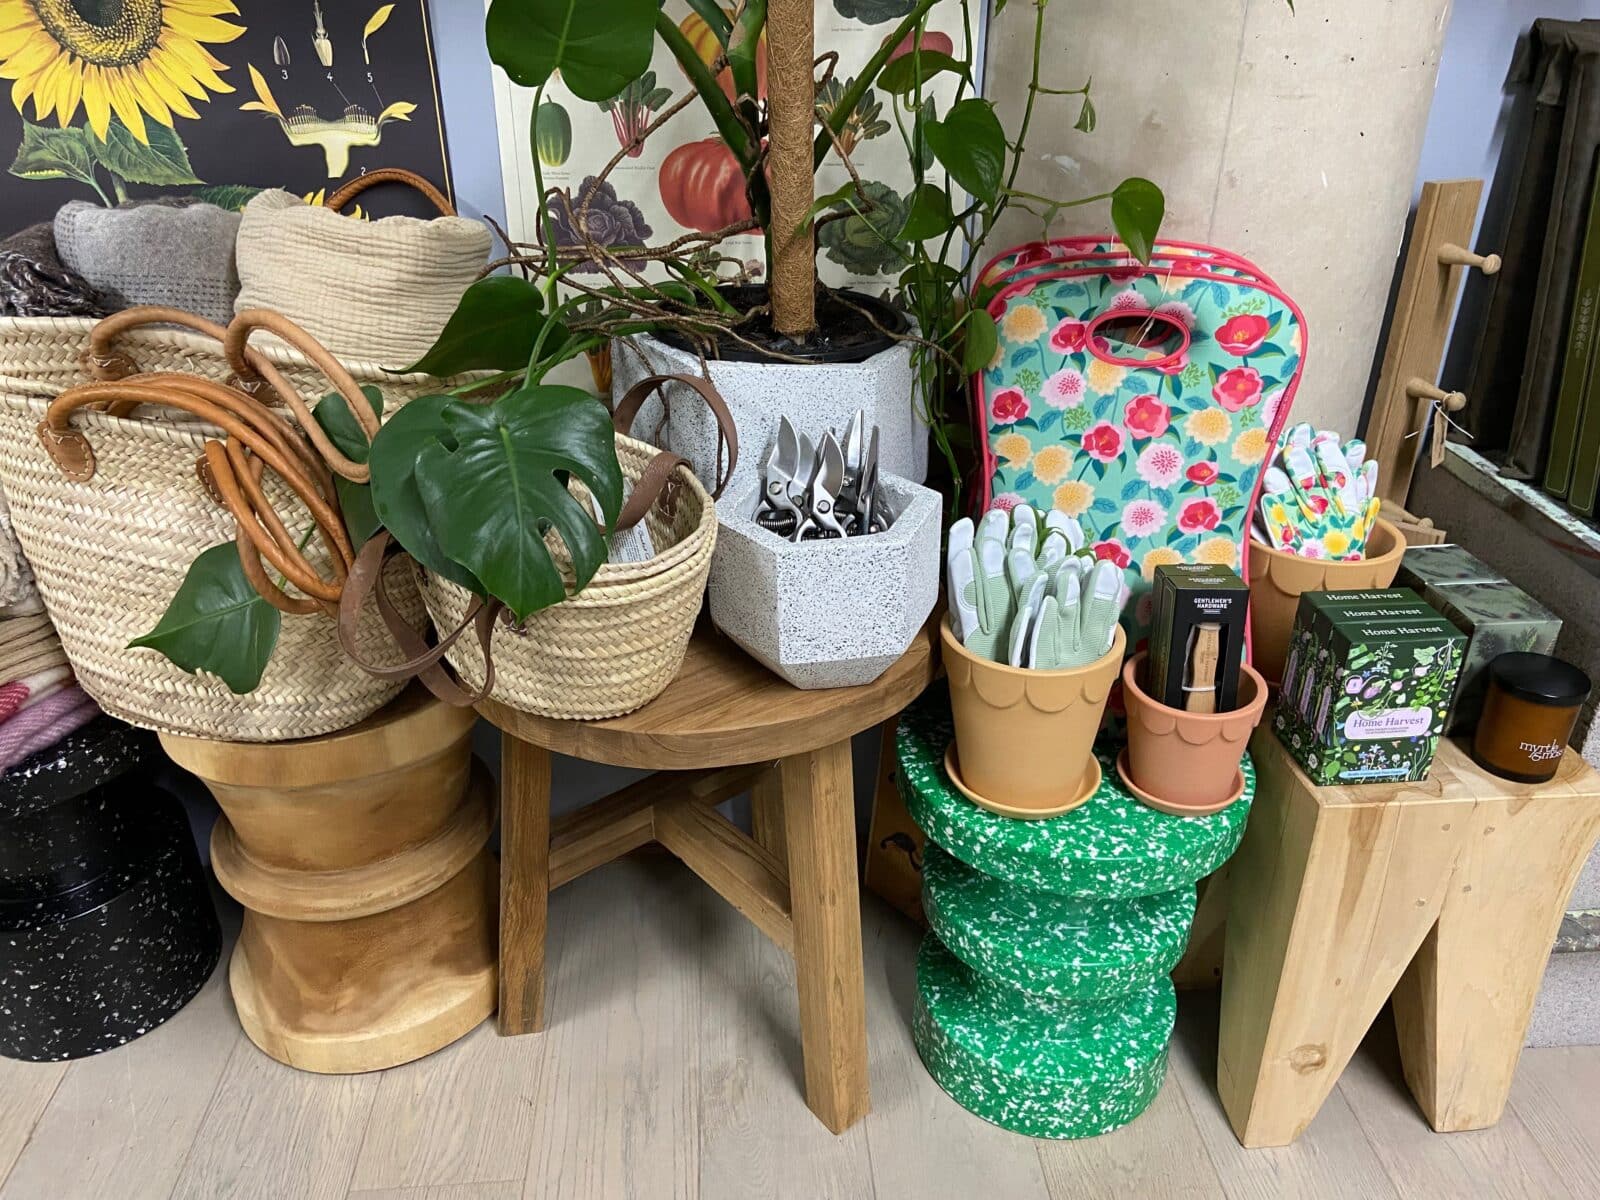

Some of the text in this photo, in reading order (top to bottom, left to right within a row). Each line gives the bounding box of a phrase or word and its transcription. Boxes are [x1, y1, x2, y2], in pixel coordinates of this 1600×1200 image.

[281, 69, 289, 80] 3
[326, 71, 334, 82] 4
[366, 72, 374, 83] 5
[360, 166, 367, 176] 2
[1377, 608, 1423, 616] Harvest
[1361, 626, 1443, 636] Home Harvest
[1353, 717, 1424, 728] Home Harvest
